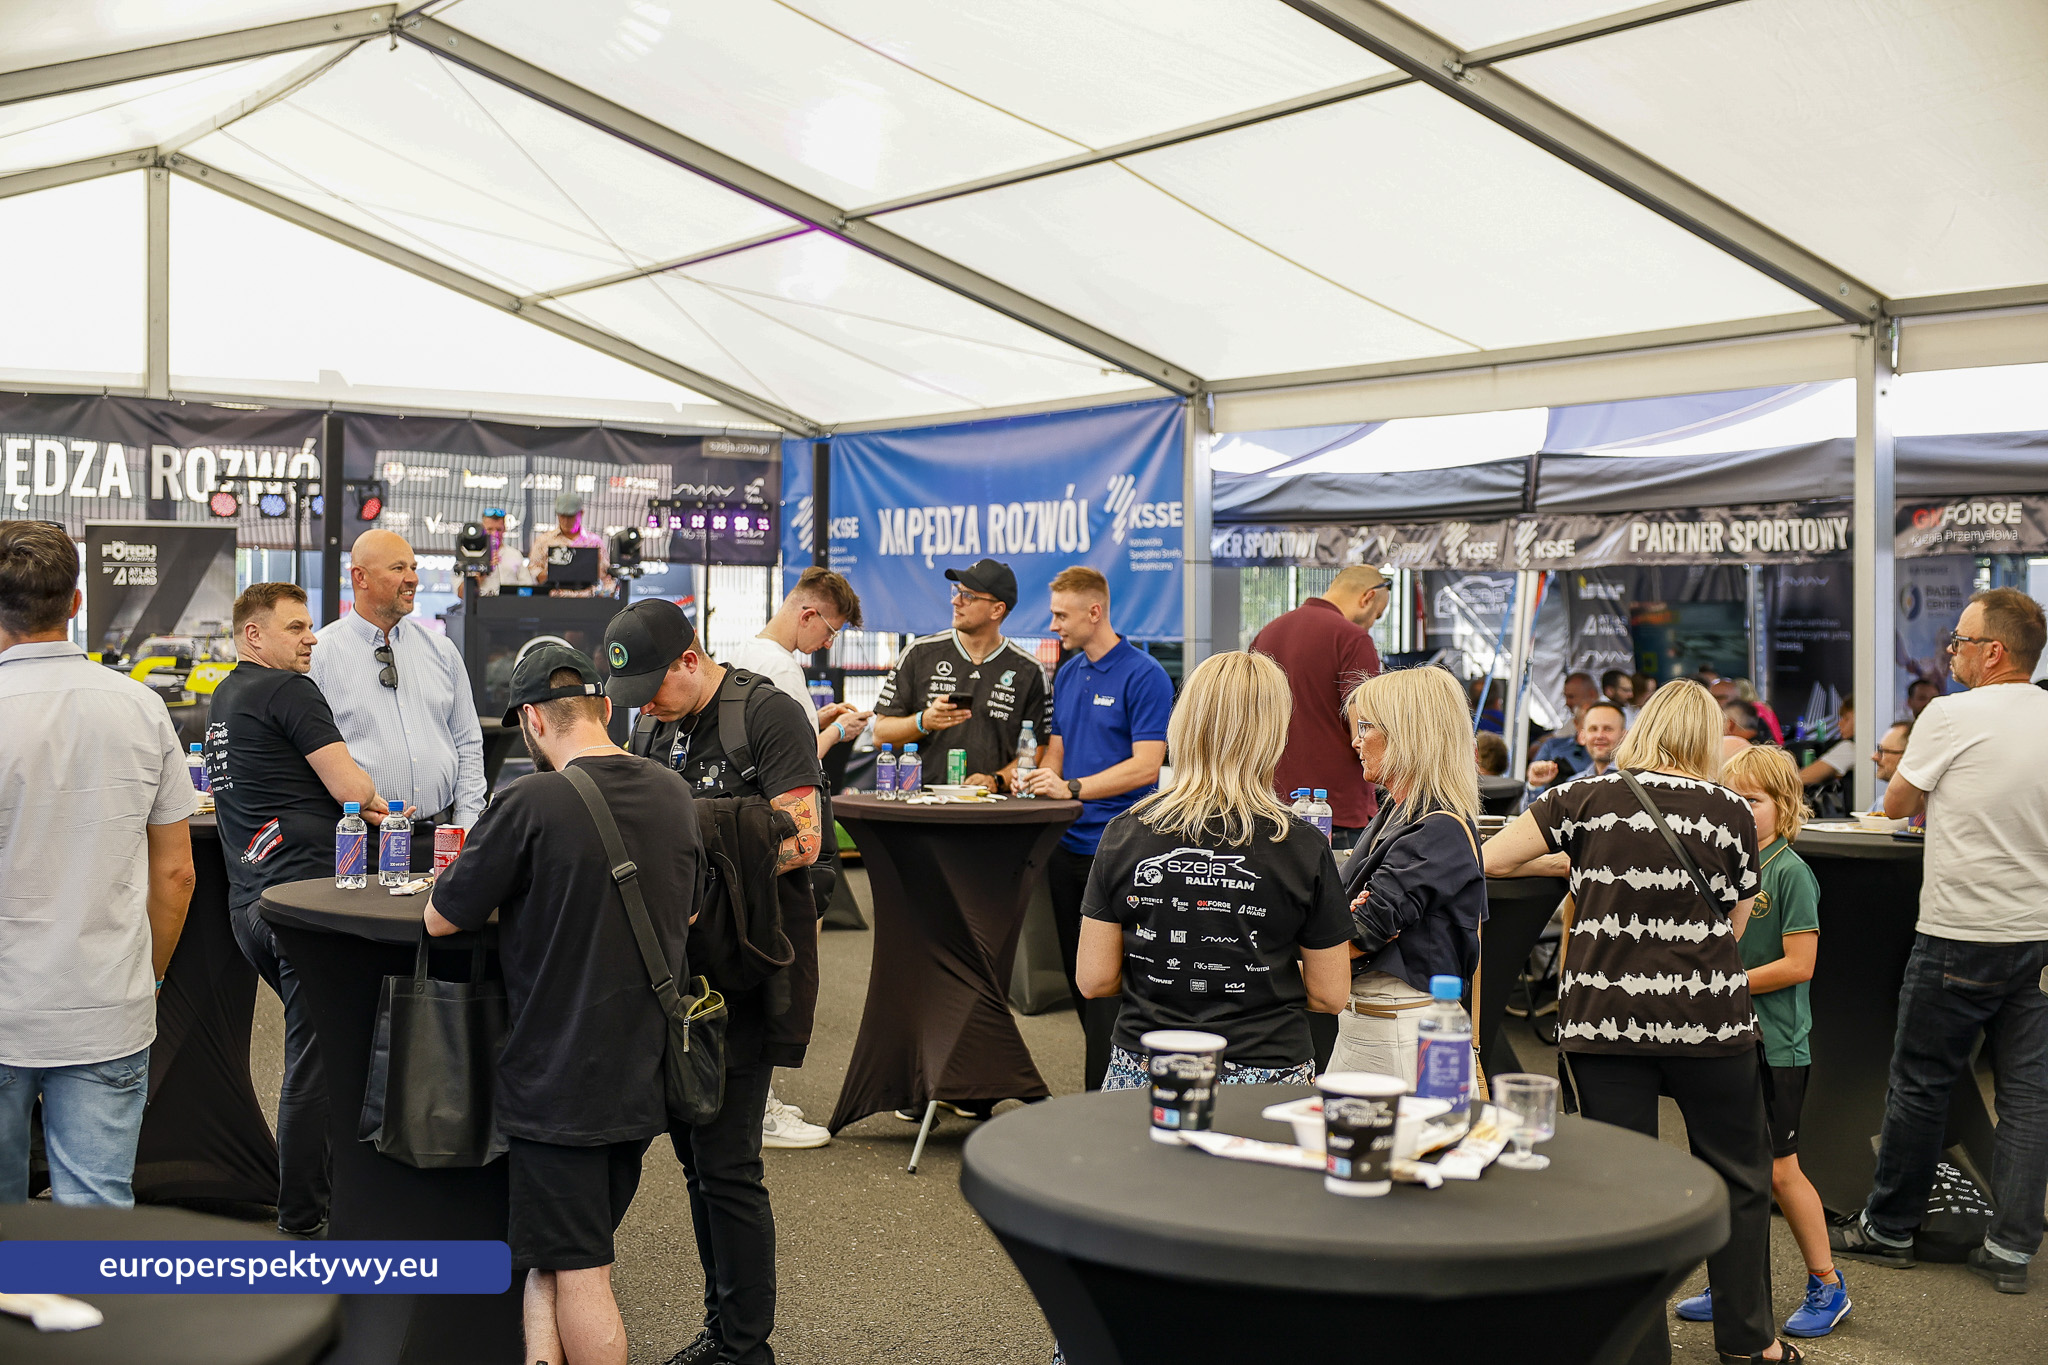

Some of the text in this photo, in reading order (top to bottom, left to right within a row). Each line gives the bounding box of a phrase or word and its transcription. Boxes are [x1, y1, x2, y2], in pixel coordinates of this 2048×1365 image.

[0, 437, 133, 512] ĘDZA
[1129, 501, 1184, 530] KSSE
[878, 483, 1091, 569] NAPĘDZA ROZWÓJ
[1629, 517, 1849, 553] PARTNER SPORTOWY
[1462, 542, 1498, 560] KSSE
[1533, 539, 1576, 559] KSSE
[991, 691, 1016, 703] INEOS
[990, 710, 1009, 721] HPE
[1186, 876, 1256, 892] RALLY TEAM
[1246, 910, 1266, 918] WARD
[1247, 905, 1267, 913] ATLAS
